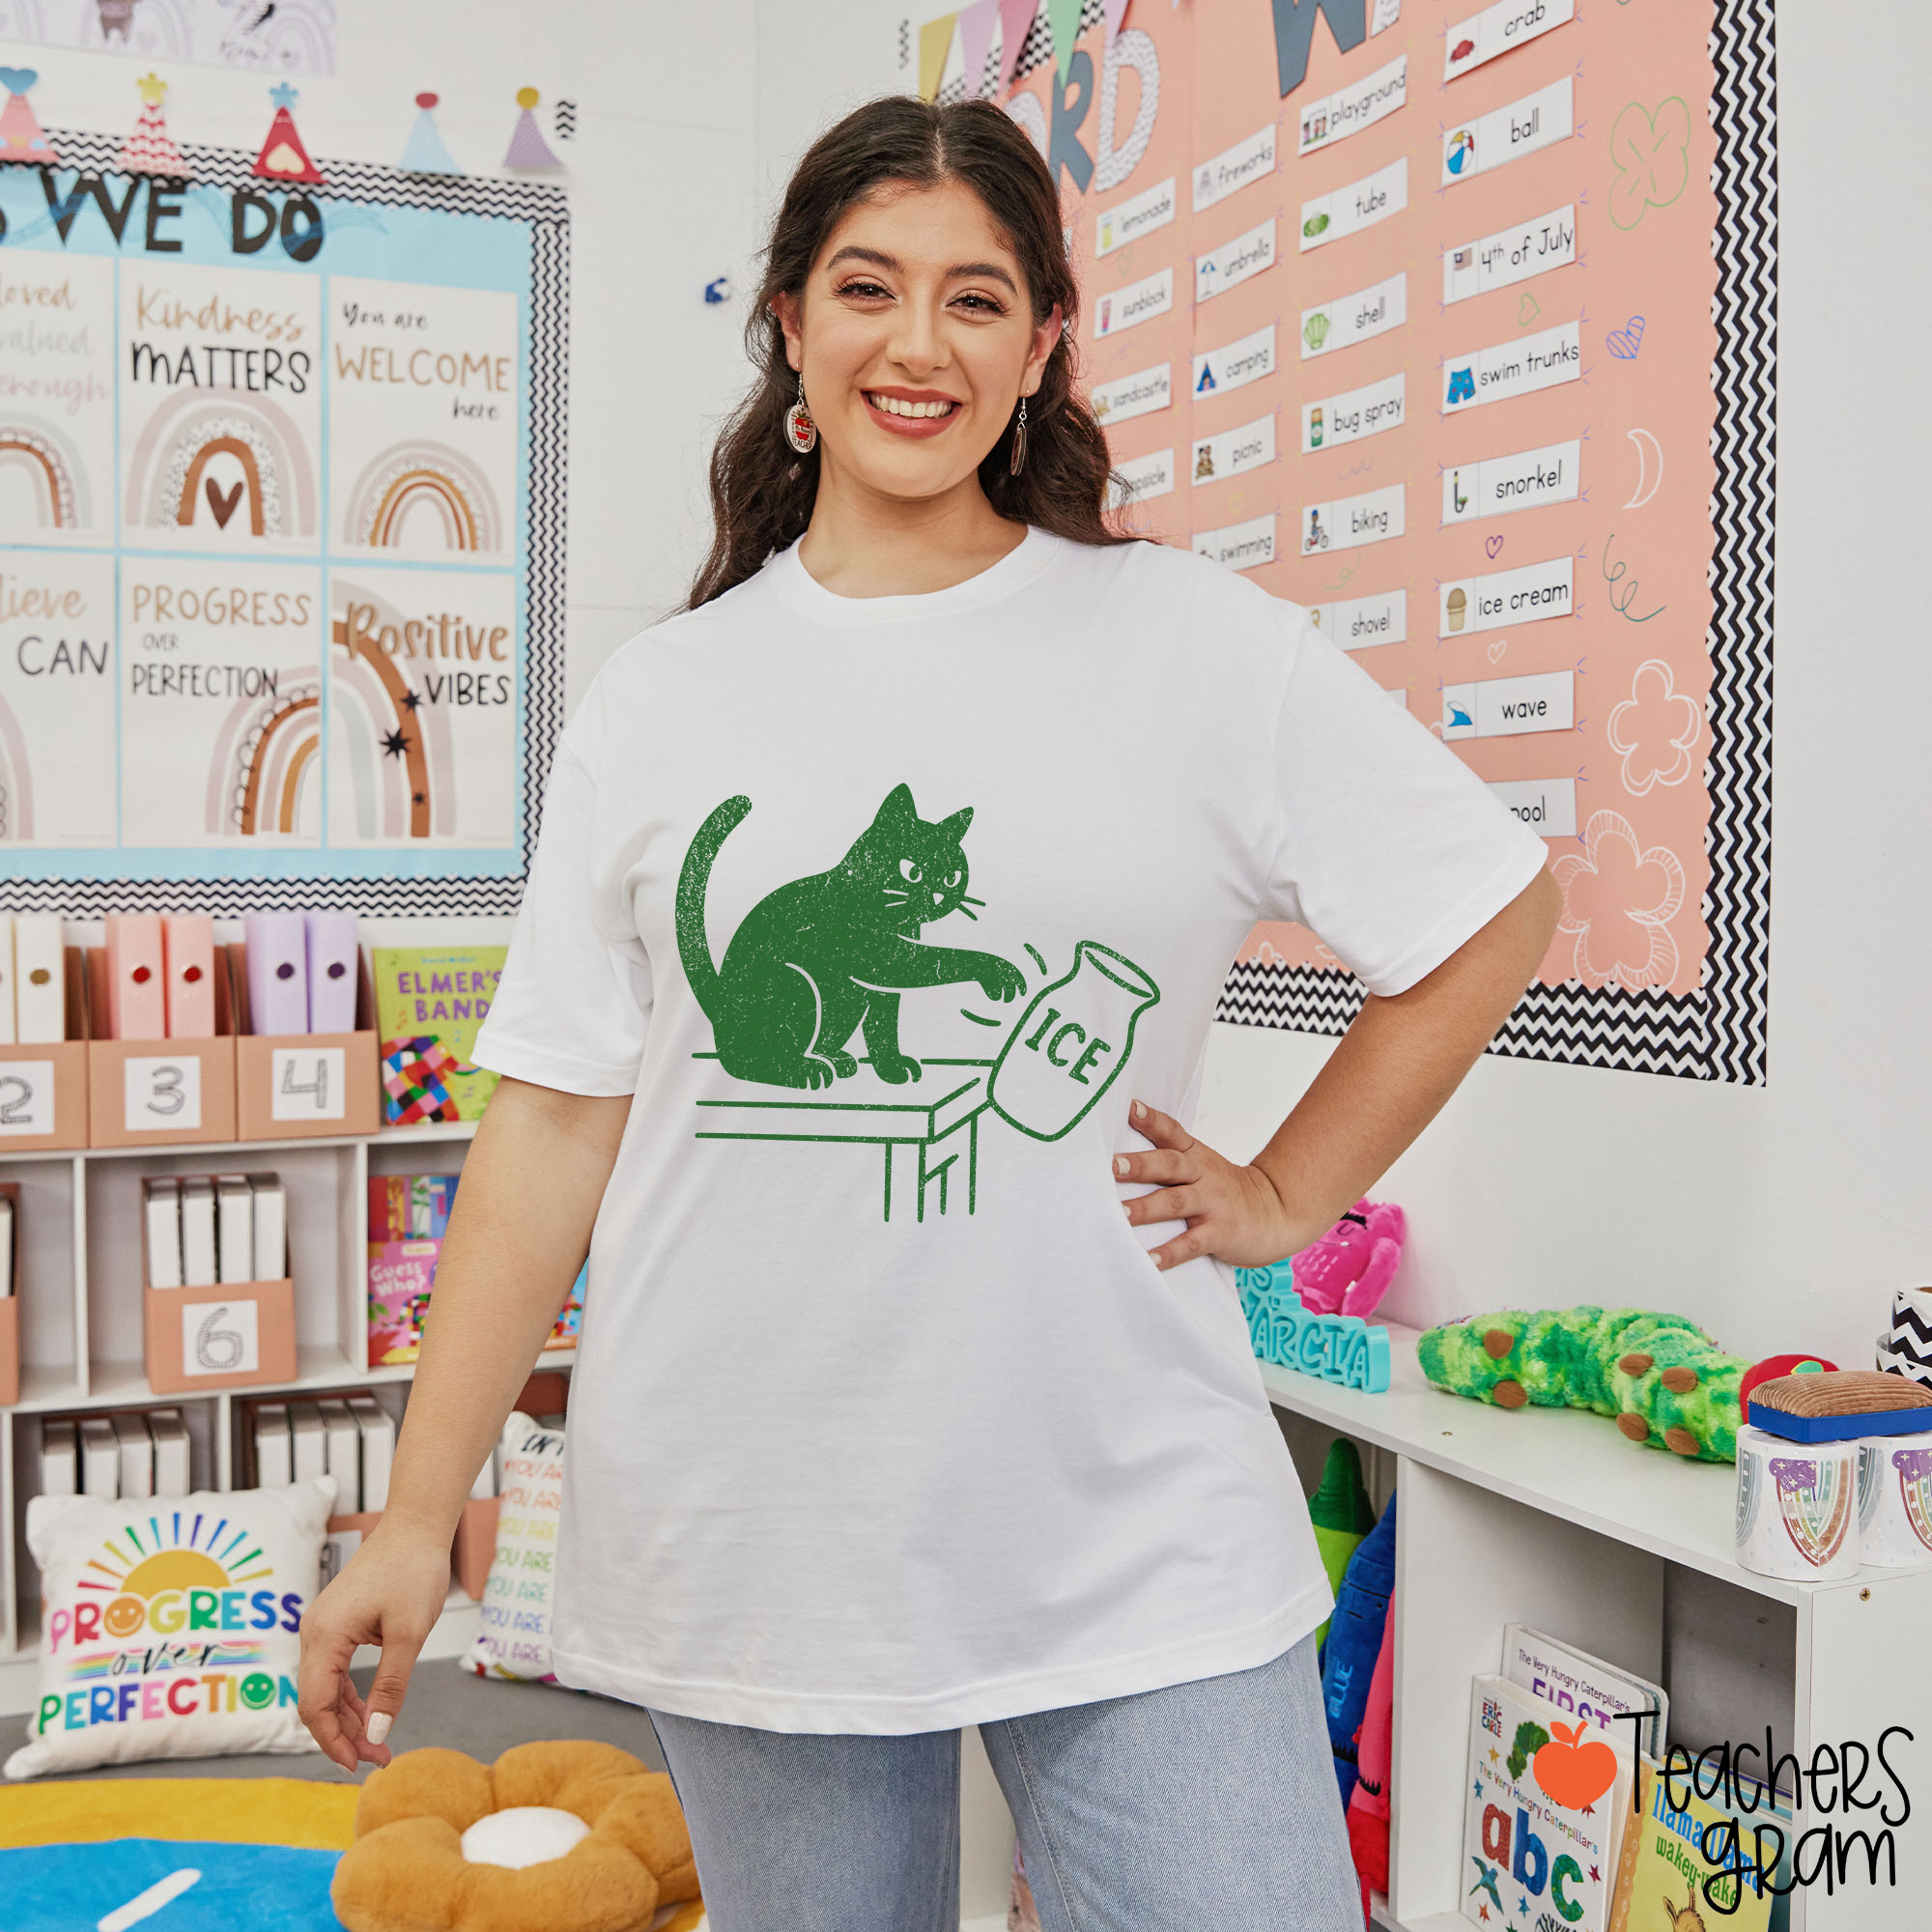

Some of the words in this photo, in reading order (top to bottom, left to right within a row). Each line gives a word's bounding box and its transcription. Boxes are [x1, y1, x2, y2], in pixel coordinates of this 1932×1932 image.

[1504, 0, 1546, 37] crab
[1330, 63, 1406, 127] playground
[1510, 107, 1540, 144] ball
[1218, 143, 1273, 187] fireworks
[40, 170, 185, 251] WE
[233, 191, 325, 263] DO
[1121, 193, 1172, 233] lemonade
[1355, 188, 1386, 216] tube
[1225, 237, 1270, 277] umbrella
[1482, 245, 1505, 273] 4th
[1511, 236, 1530, 266] of
[1538, 222, 1573, 256] July
[137, 286, 305, 342] Kindness
[1123, 282, 1166, 318] sunblock
[1355, 296, 1385, 329] shell
[335, 341, 511, 391] WELCOME
[1225, 349, 1268, 379] camping
[1480, 363, 1520, 386] swim
[1527, 340, 1579, 374] trunks
[452, 396, 500, 420] here
[1113, 372, 1169, 408] sandcastle
[1334, 410, 1360, 433] bug
[1364, 397, 1404, 427] spray
[1233, 440, 1263, 469] picnic
[1495, 459, 1562, 498] snorkel
[1351, 508, 1388, 533] biking
[1220, 536, 1272, 562] swimming
[133, 583, 312, 626] PROGRESS
[1479, 597, 1503, 616] ice
[1510, 584, 1569, 611] cream
[348, 601, 509, 661] Positive
[1351, 606, 1390, 637] shovel
[17, 635, 109, 675] CAN
[144, 632, 180, 651] OVER
[132, 663, 277, 697] PERFECTION
[425, 672, 511, 705] VIBES
[1502, 700, 1548, 720] wave
[415, 999, 490, 1022] BAND
[1024, 1008, 1112, 1086] ICE
[0, 1066, 34, 1124] 2
[147, 1065, 185, 1116] 3
[281, 1059, 328, 1109] 4
[370, 1262, 422, 1282] Guess
[376, 1274, 427, 1296] Who?
[195, 1306, 244, 1369] 6
[1246, 1297, 1370, 1387] ARCIA
[521, 1549, 554, 1573] ARE
[517, 1580, 549, 1605] ARE
[51, 1590, 303, 1654] PROGRESS
[513, 1610, 546, 1635] ARE
[111, 1642, 224, 1676] over
[511, 1641, 543, 1663] ARE
[1328, 1657, 1353, 1719] BLUE
[1519, 1648, 1531, 1665] The
[1533, 1656, 1549, 1676] Very
[1551, 1665, 1579, 1690] Hungry
[1581, 1680, 1631, 1714] Caterpillar's
[1481, 1715, 1501, 1739] CARLE
[1483, 1701, 1502, 1725] ERIC
[1479, 1760, 1492, 1779] The
[1494, 1772, 1512, 1797] Very
[1513, 1786, 1543, 1820] Hungry
[1545, 1809, 1598, 1854] Caterpillar's
[1482, 1803, 1584, 1922] abc
